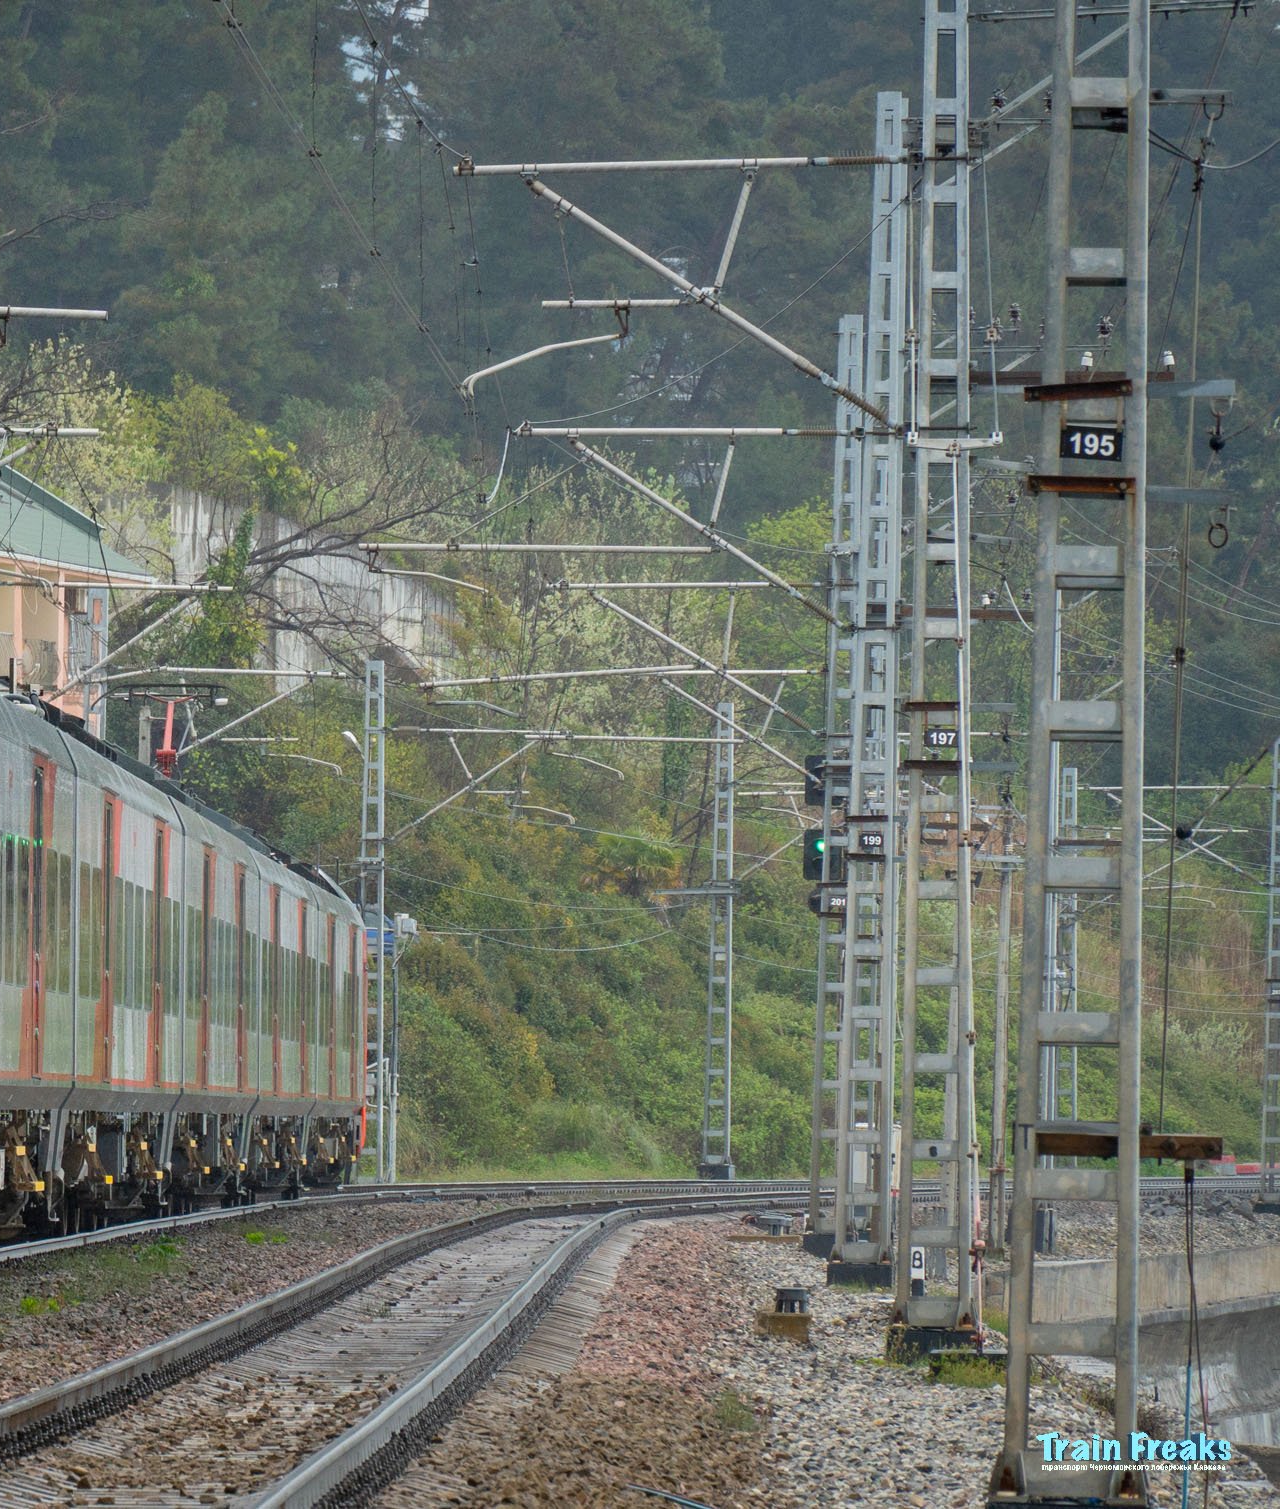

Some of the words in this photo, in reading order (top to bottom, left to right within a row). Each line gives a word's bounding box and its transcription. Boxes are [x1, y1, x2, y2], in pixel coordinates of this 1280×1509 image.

[1069, 432, 1115, 457] 195
[930, 732, 957, 746] 197
[862, 835, 881, 846] 199
[830, 897, 846, 907] 201
